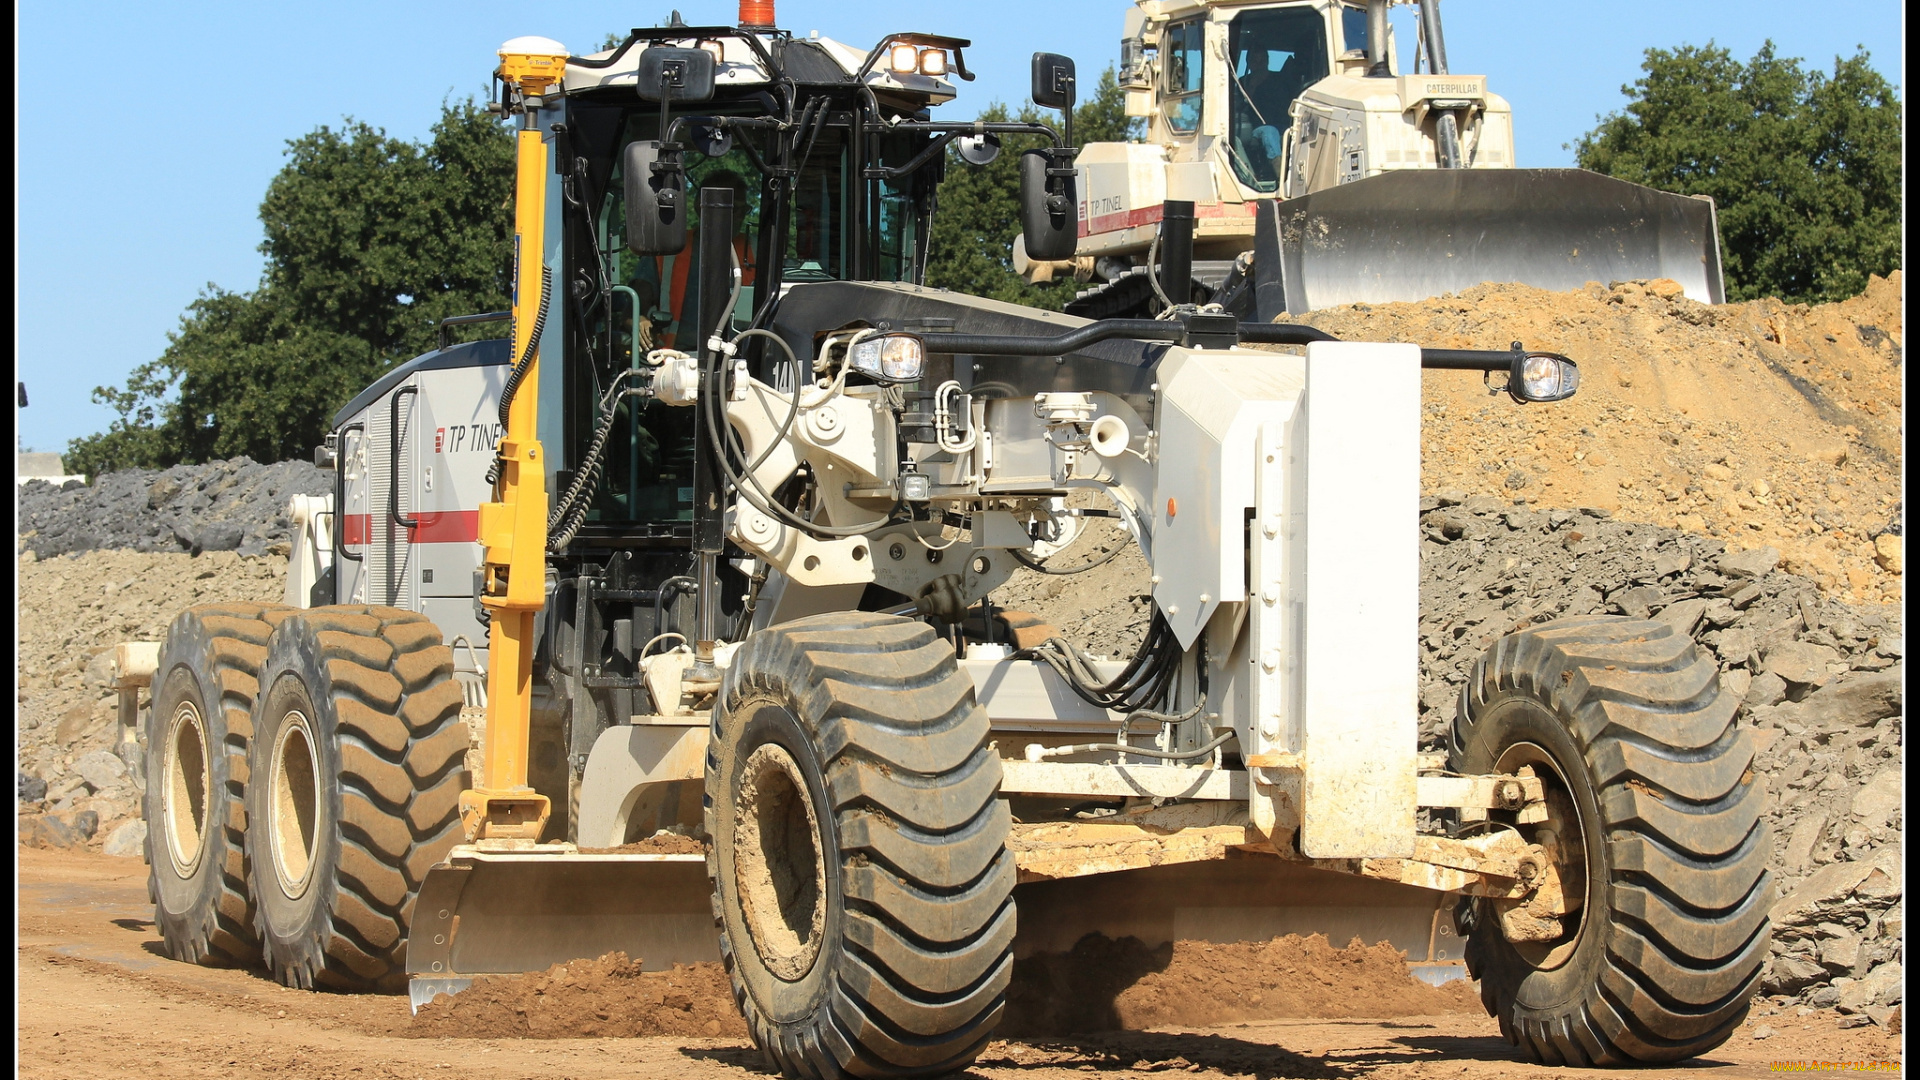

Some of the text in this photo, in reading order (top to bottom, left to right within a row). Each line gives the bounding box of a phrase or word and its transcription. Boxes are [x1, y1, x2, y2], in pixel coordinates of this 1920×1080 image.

[1426, 84, 1478, 94] CATERPILLAR
[1090, 195, 1123, 216] TP TINEL
[449, 425, 466, 453] TP
